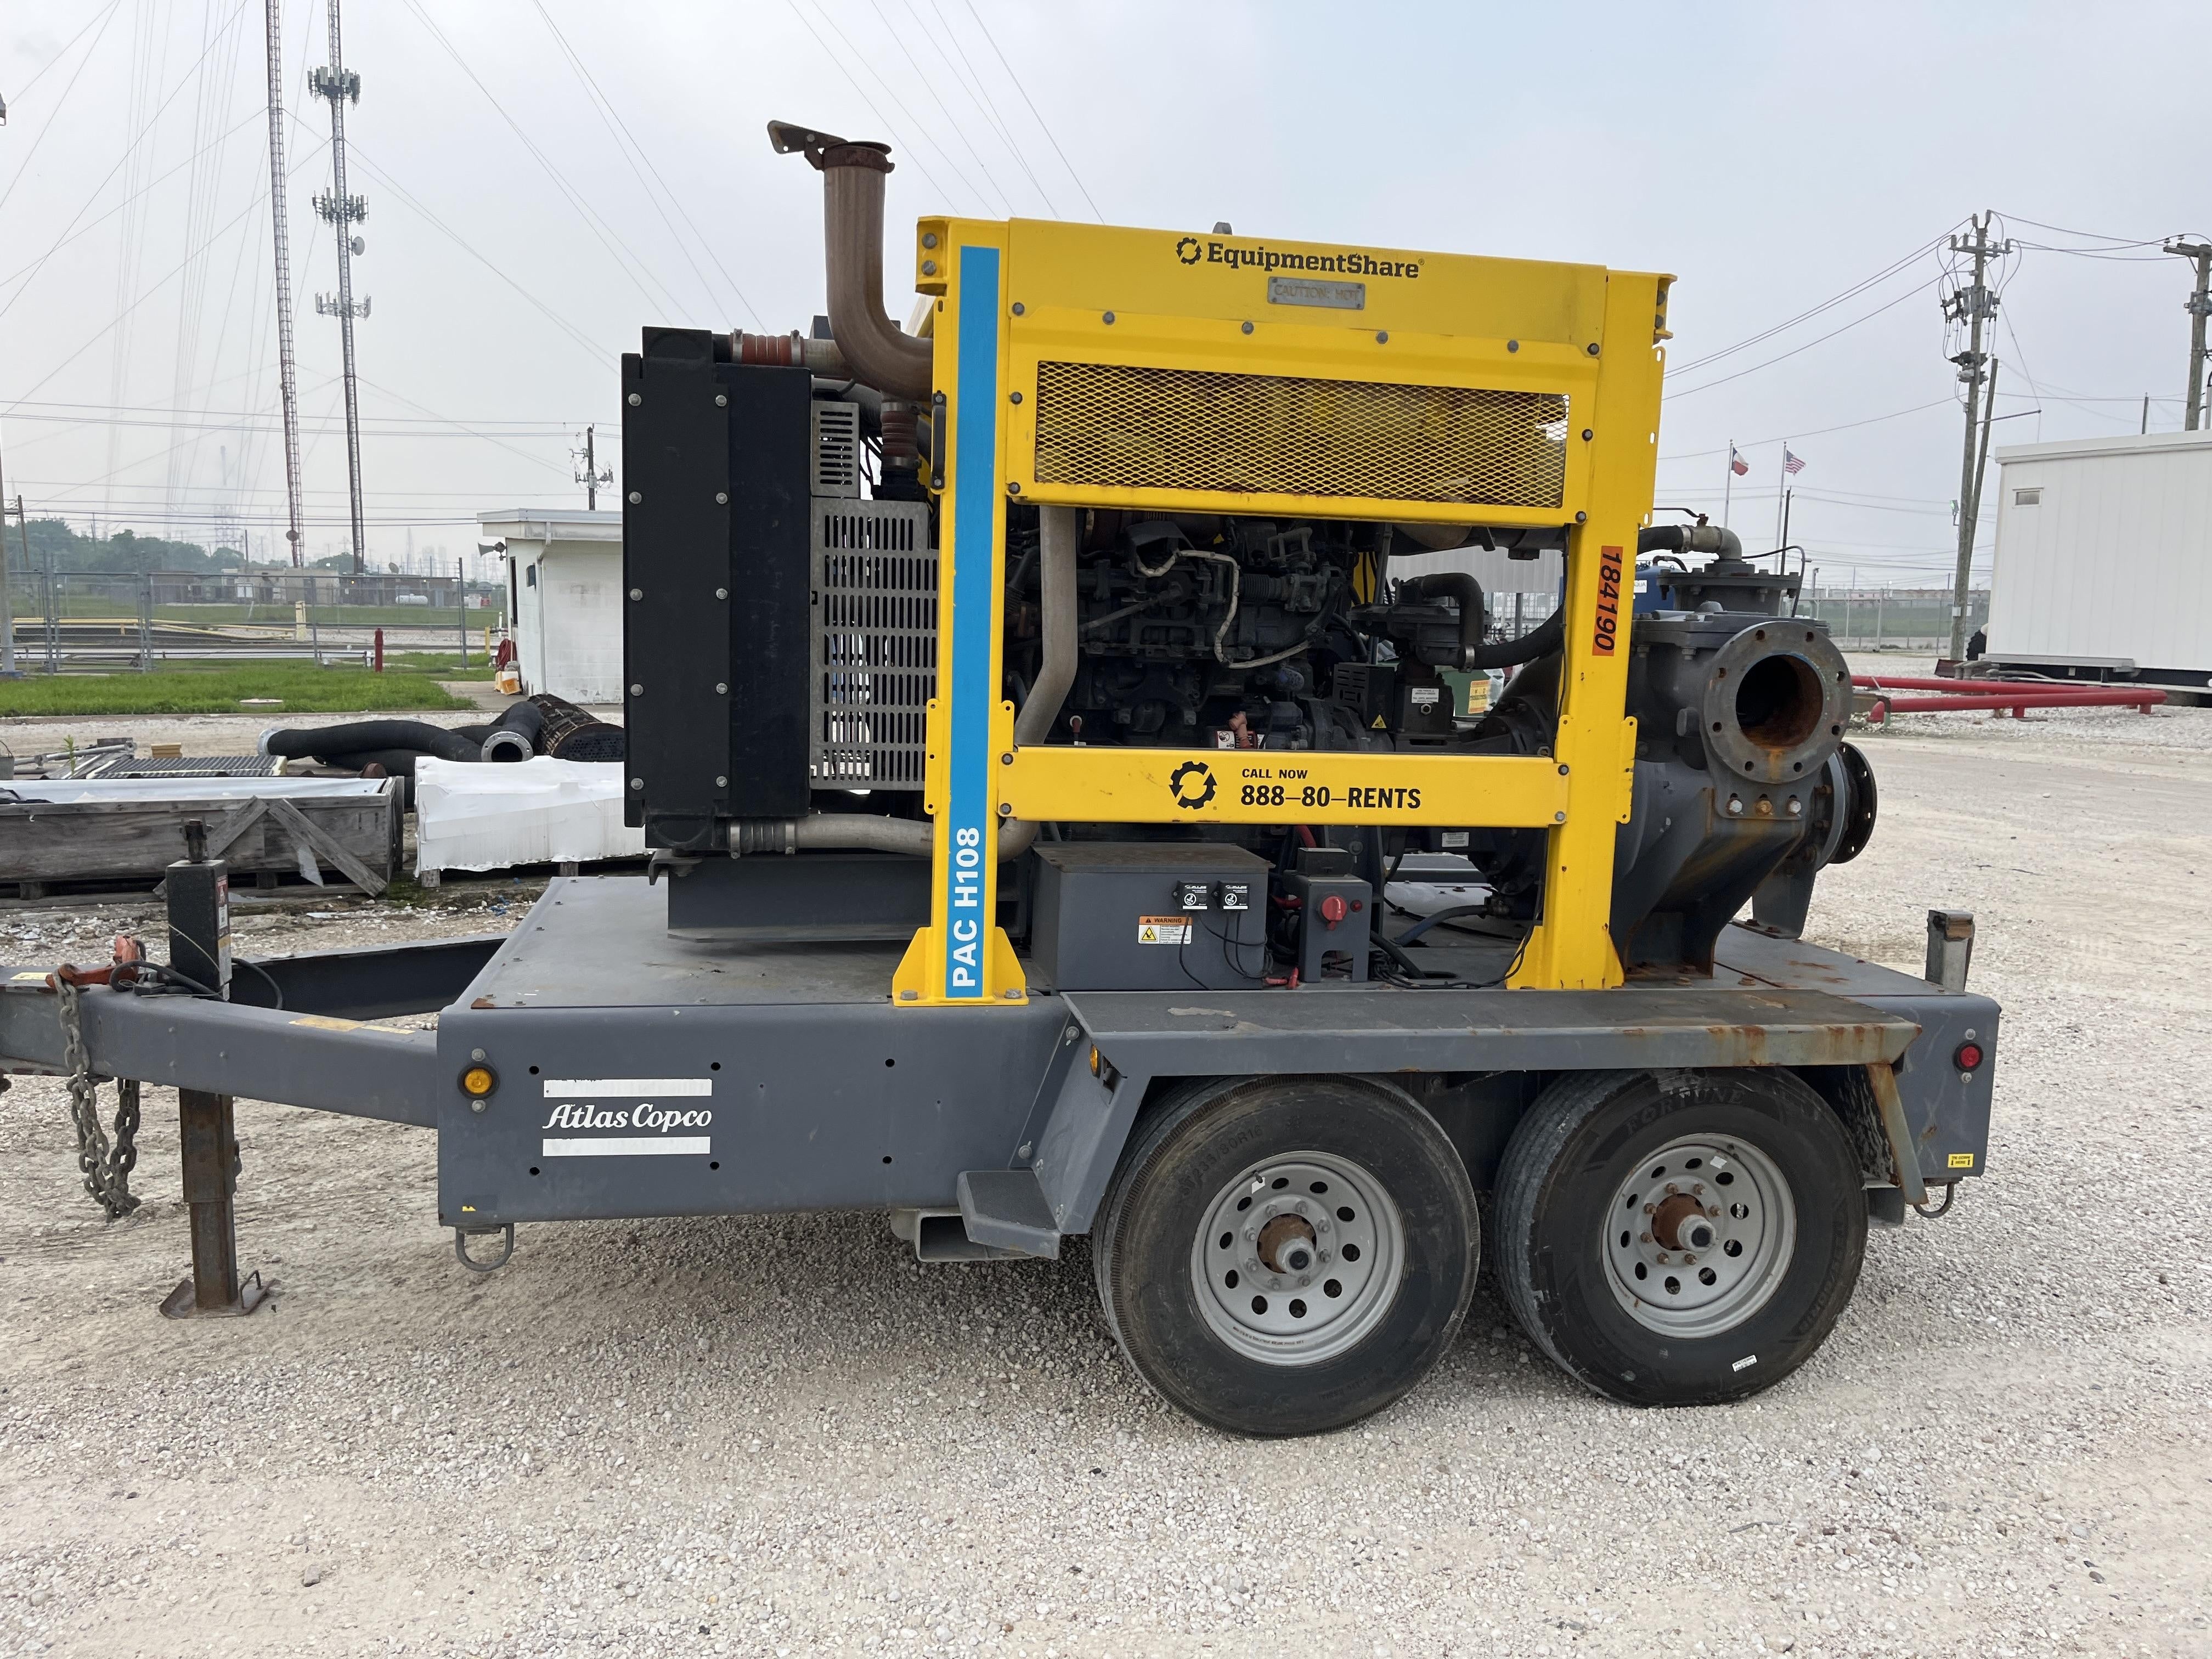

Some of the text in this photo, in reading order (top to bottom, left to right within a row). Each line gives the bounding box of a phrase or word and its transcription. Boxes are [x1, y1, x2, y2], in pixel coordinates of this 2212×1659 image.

[1594, 552, 1622, 651] 184190
[1242, 768, 1308, 780] CALL NOW
[952, 827, 980, 987] PAC H108
[542, 1103, 712, 1133] Atlas Copco
